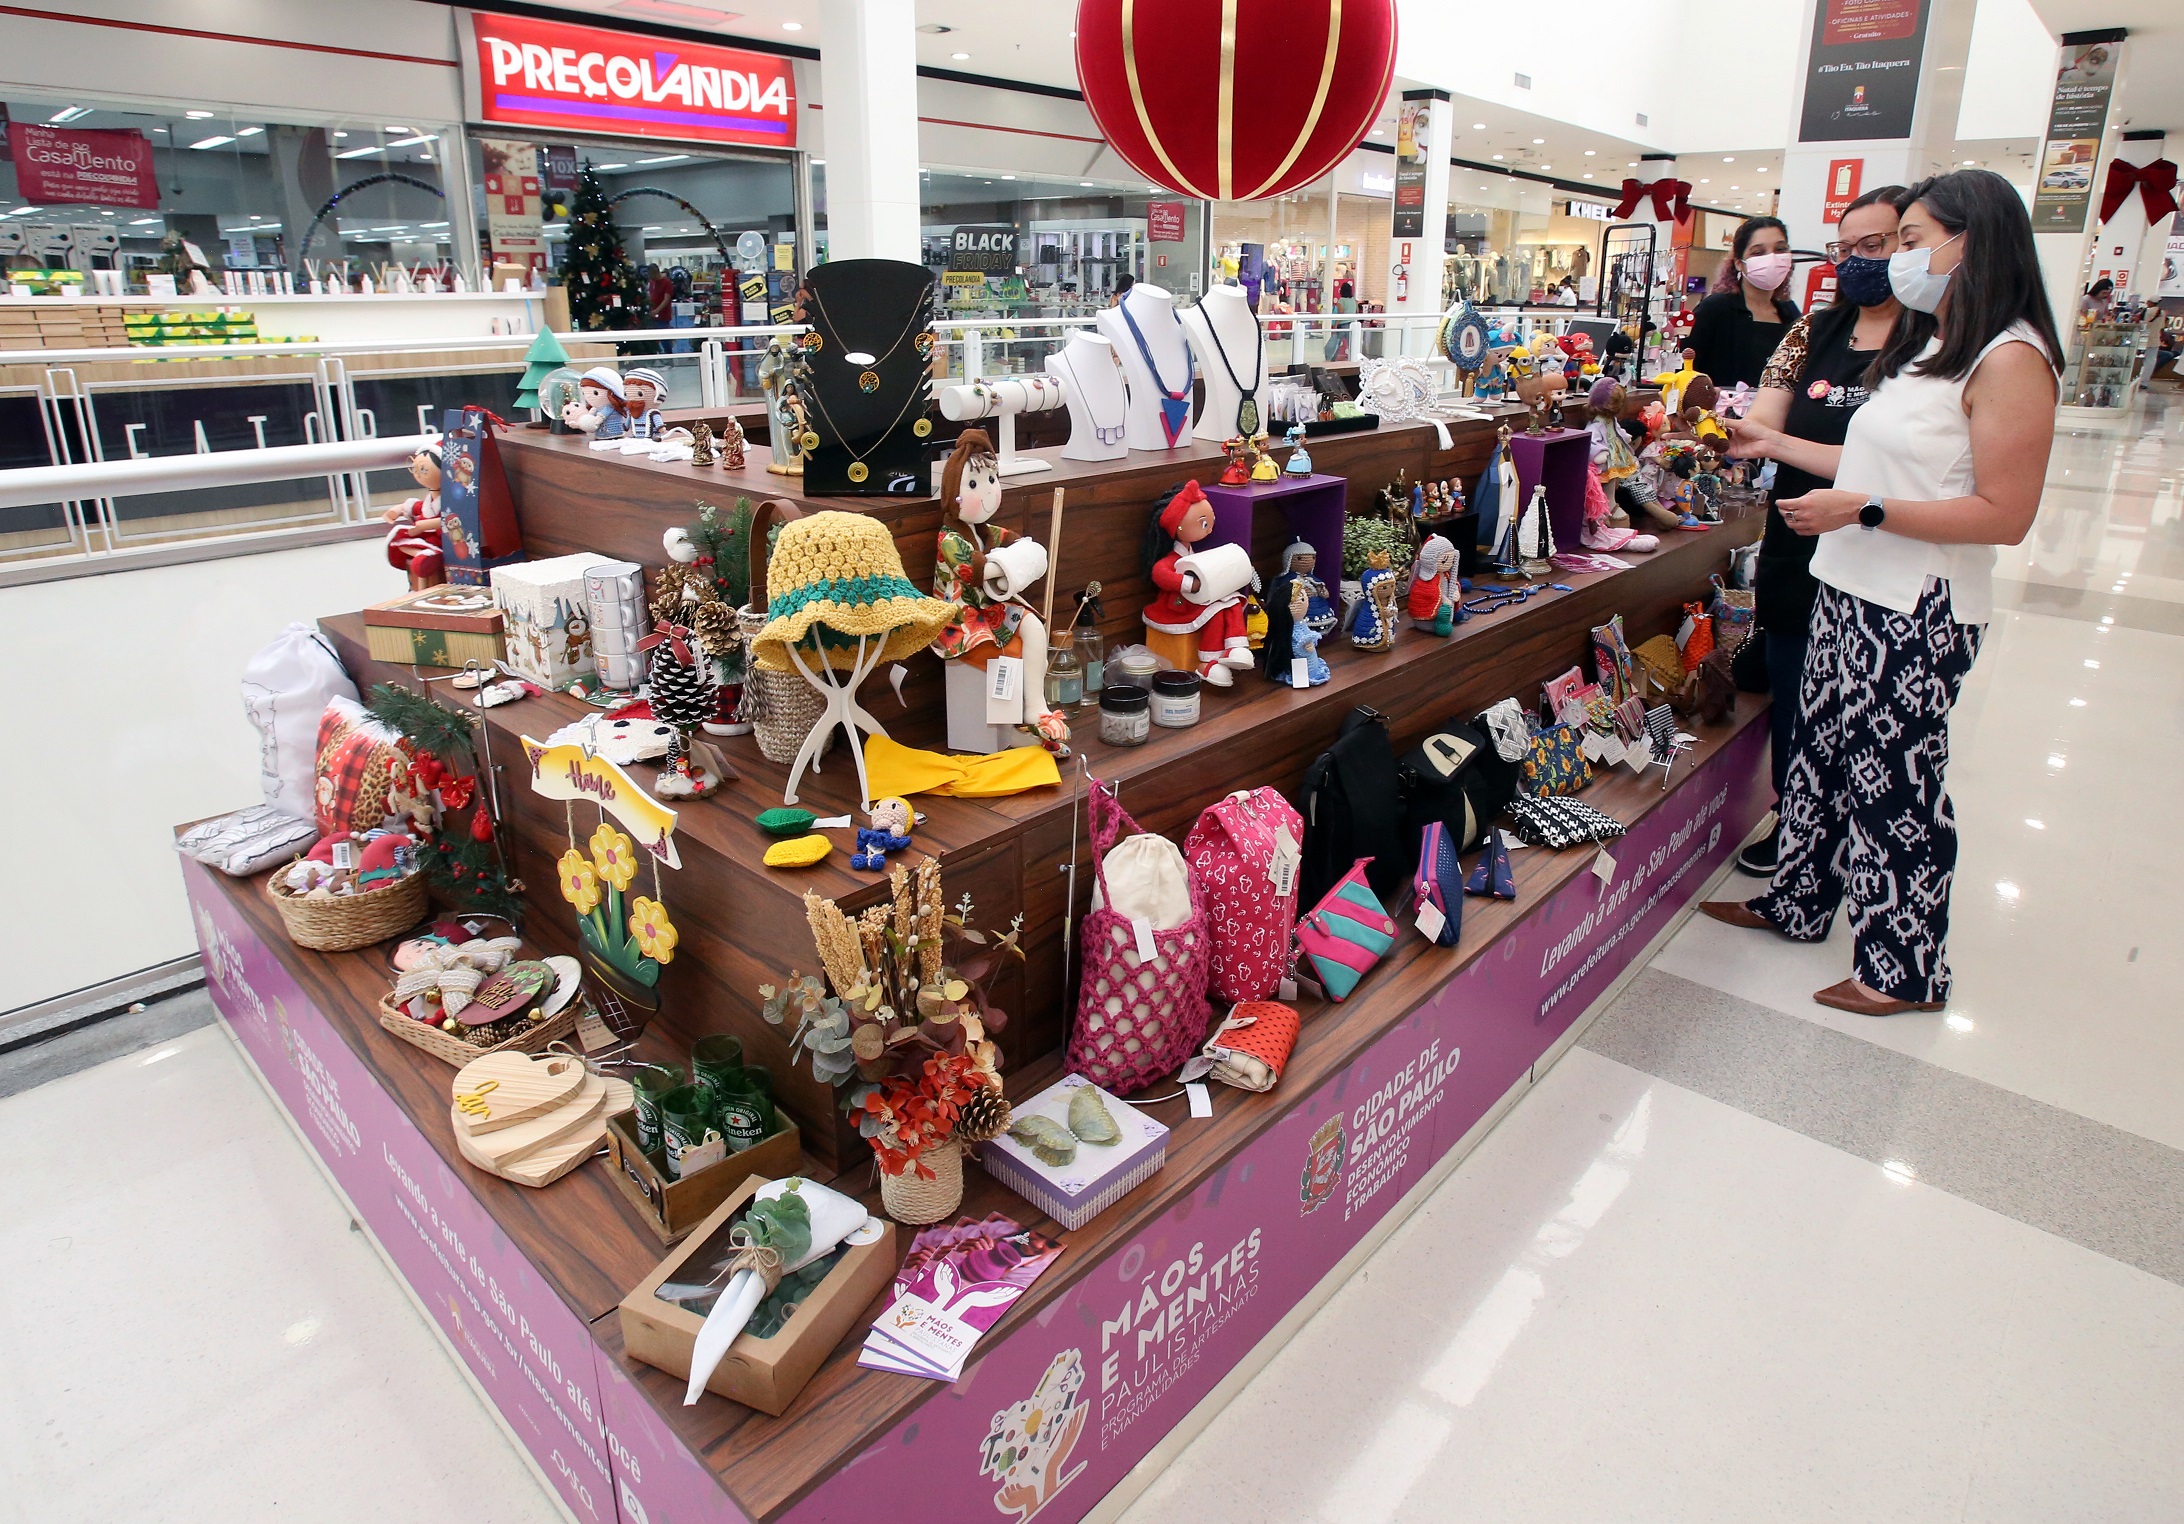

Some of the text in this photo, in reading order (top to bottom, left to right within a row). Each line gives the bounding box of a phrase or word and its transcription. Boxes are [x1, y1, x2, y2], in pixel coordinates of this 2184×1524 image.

[1831, 16, 1862, 25] OFICINAS
[1870, 11, 1909, 20] ATIVIDADES
[483, 37, 795, 116] PREÇOLANDIA
[1872, 60, 1910, 70] Itaquera
[26, 136, 69, 149] Lista de
[26, 143, 136, 172] Casamento
[551, 161, 576, 174] 10X
[953, 253, 1013, 270] FRIDAY
[955, 232, 1014, 251] BLACK
[565, 760, 616, 800] Home
[1540, 781, 1728, 979] Levando a arte de São Paulo até você
[1541, 842, 1707, 1016] www.prefeitura.sp.gov.br/maosementes
[321, 1083, 361, 1148] PAULO
[736, 1106, 758, 1123] ORIGINAL
[1349, 1047, 1461, 1166] SÃO PAULO
[1353, 1038, 1440, 1130] CIDADE DE
[1346, 1136, 1410, 1204] ECONÔMICO
[1348, 1089, 1444, 1187] DESENVOLVIMENTO
[1344, 1153, 1408, 1221] E TRABALHO
[382, 1141, 429, 1217] Levando
[431, 1206, 439, 1229] a
[441, 1219, 466, 1264] arte
[469, 1255, 487, 1288] de
[488, 1276, 517, 1327] São
[519, 1313, 562, 1384] Paulo
[566, 1380, 593, 1423] até
[596, 1415, 641, 1483] você
[926, 1315, 953, 1333] MÃOS
[1102, 1241, 1204, 1354] MÃOS
[1102, 1227, 1262, 1393] E MENTES
[395, 1194, 612, 1484] www.prefeitura.sp.gov.br/maosementes
[920, 1321, 927, 1329] E
[928, 1326, 963, 1348] MENTES
[1101, 1284, 1258, 1438] PROGRAMA DE ARTESANATO
[1102, 1260, 1259, 1421] PAULISTANAS
[1101, 1351, 1200, 1451] E MANUALIDADES
